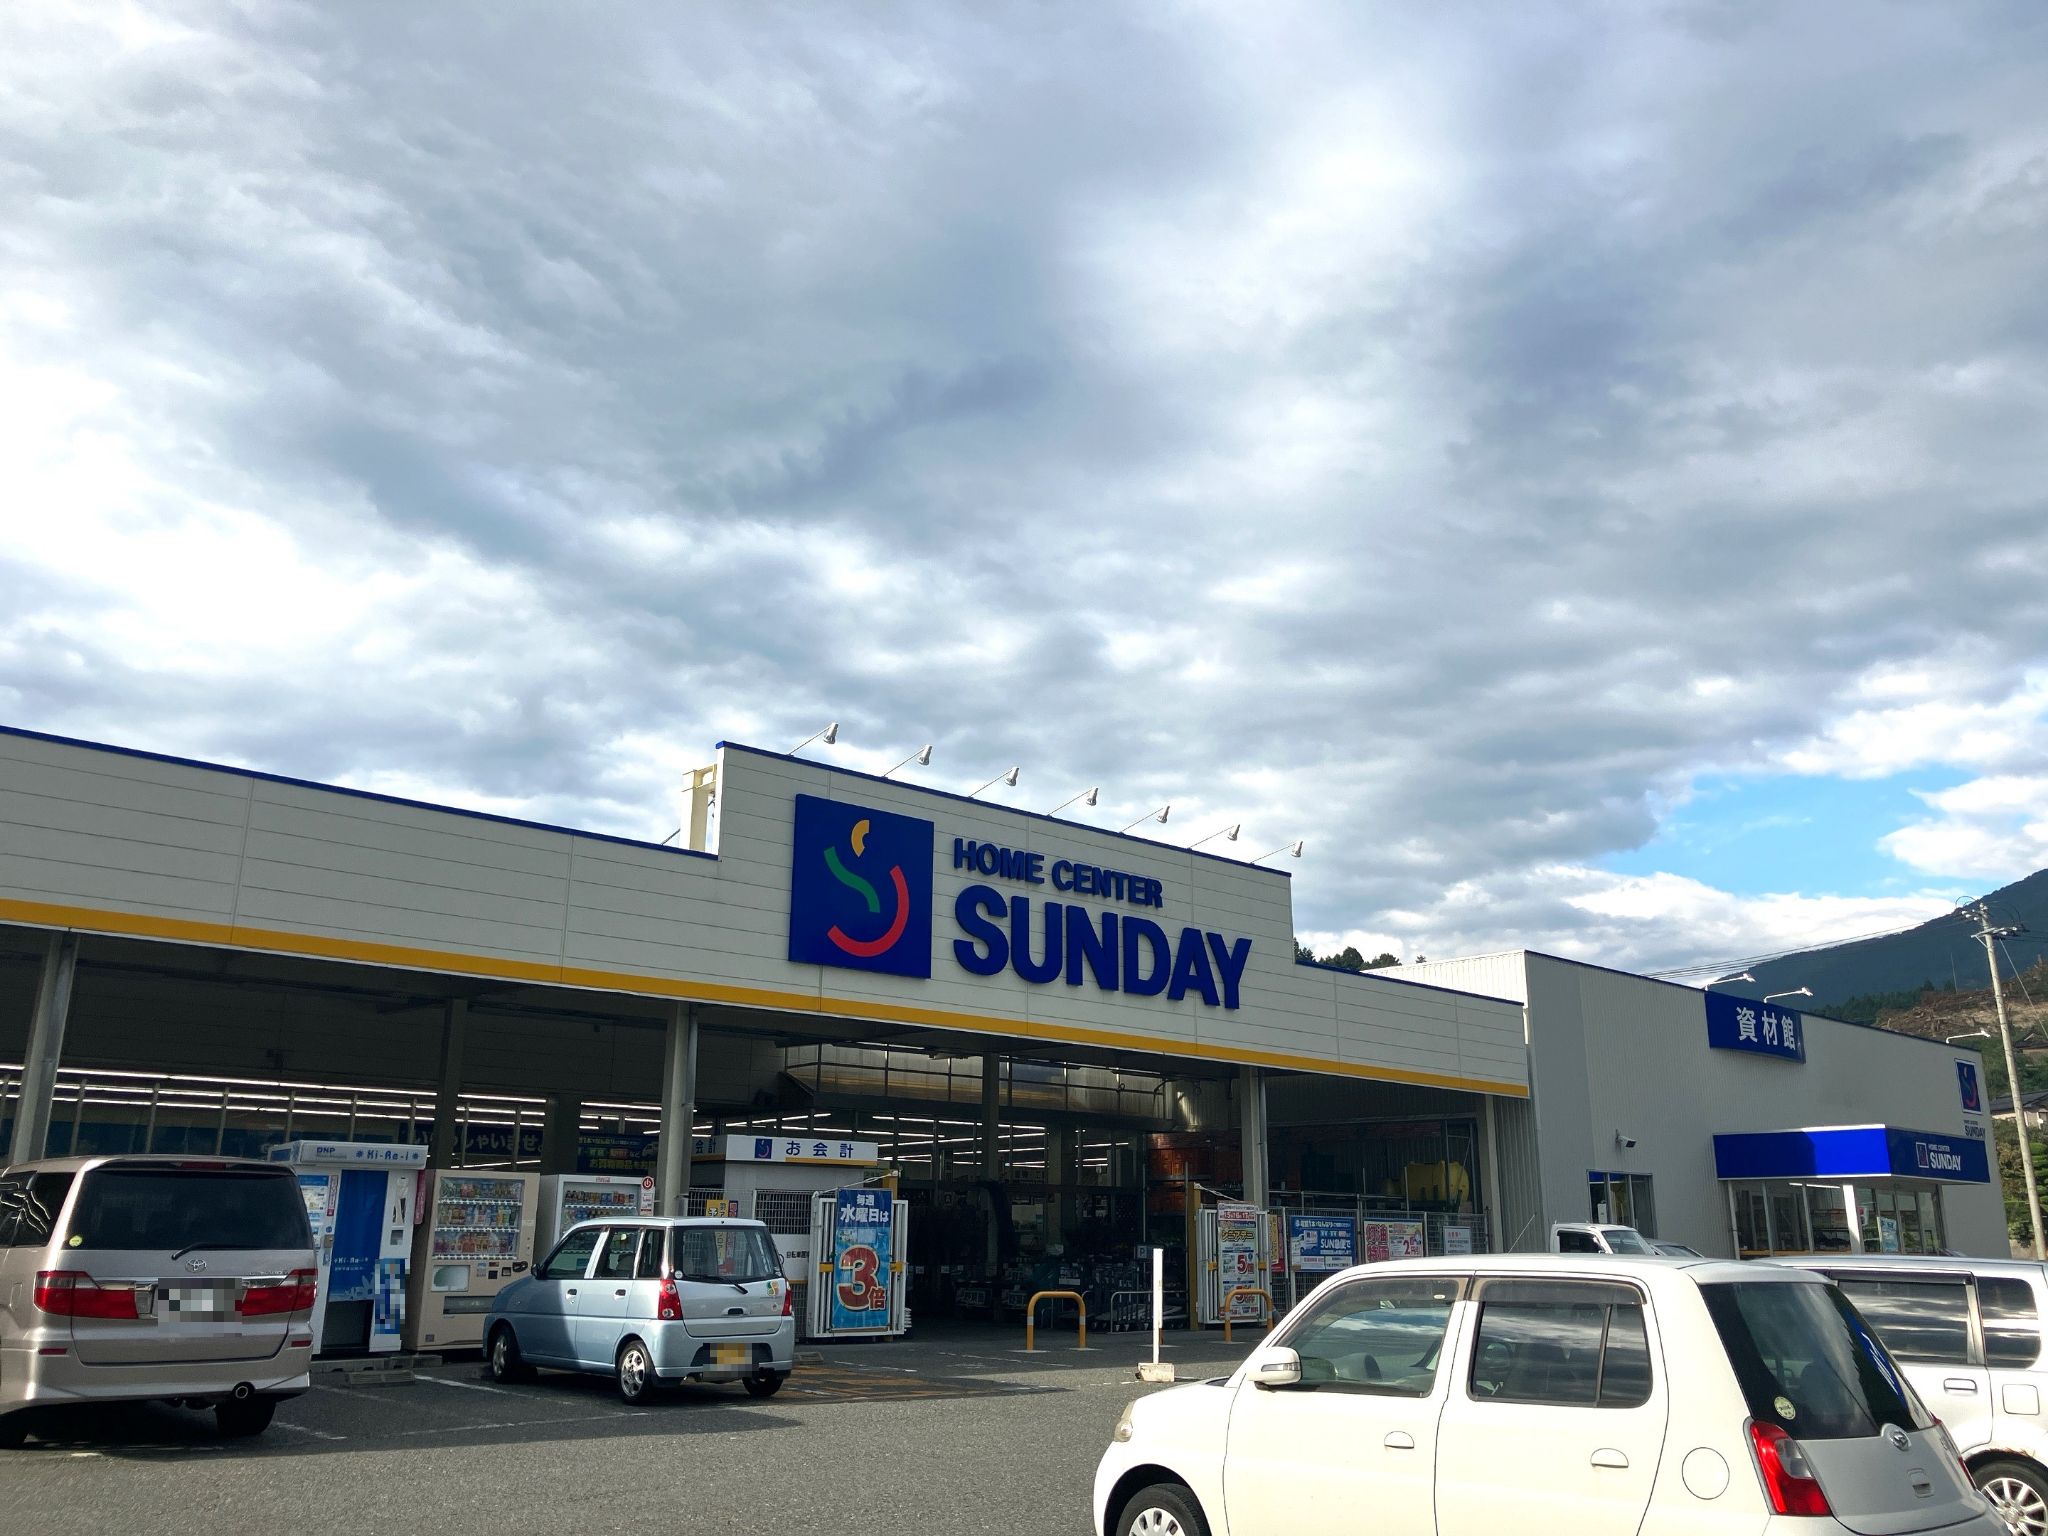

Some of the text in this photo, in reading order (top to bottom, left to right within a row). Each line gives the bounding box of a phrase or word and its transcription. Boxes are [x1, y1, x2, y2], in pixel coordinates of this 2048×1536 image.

[954, 838, 1163, 908] HOME CENTER
[953, 885, 1253, 1010] SUNDAY
[1736, 1007, 1796, 1050] 資材館
[785, 1140, 854, 1159] お会計
[1930, 1152, 1961, 1171] SUNDAY
[856, 1194, 875, 1206] 毎週
[840, 1203, 889, 1223] 水曜日は
